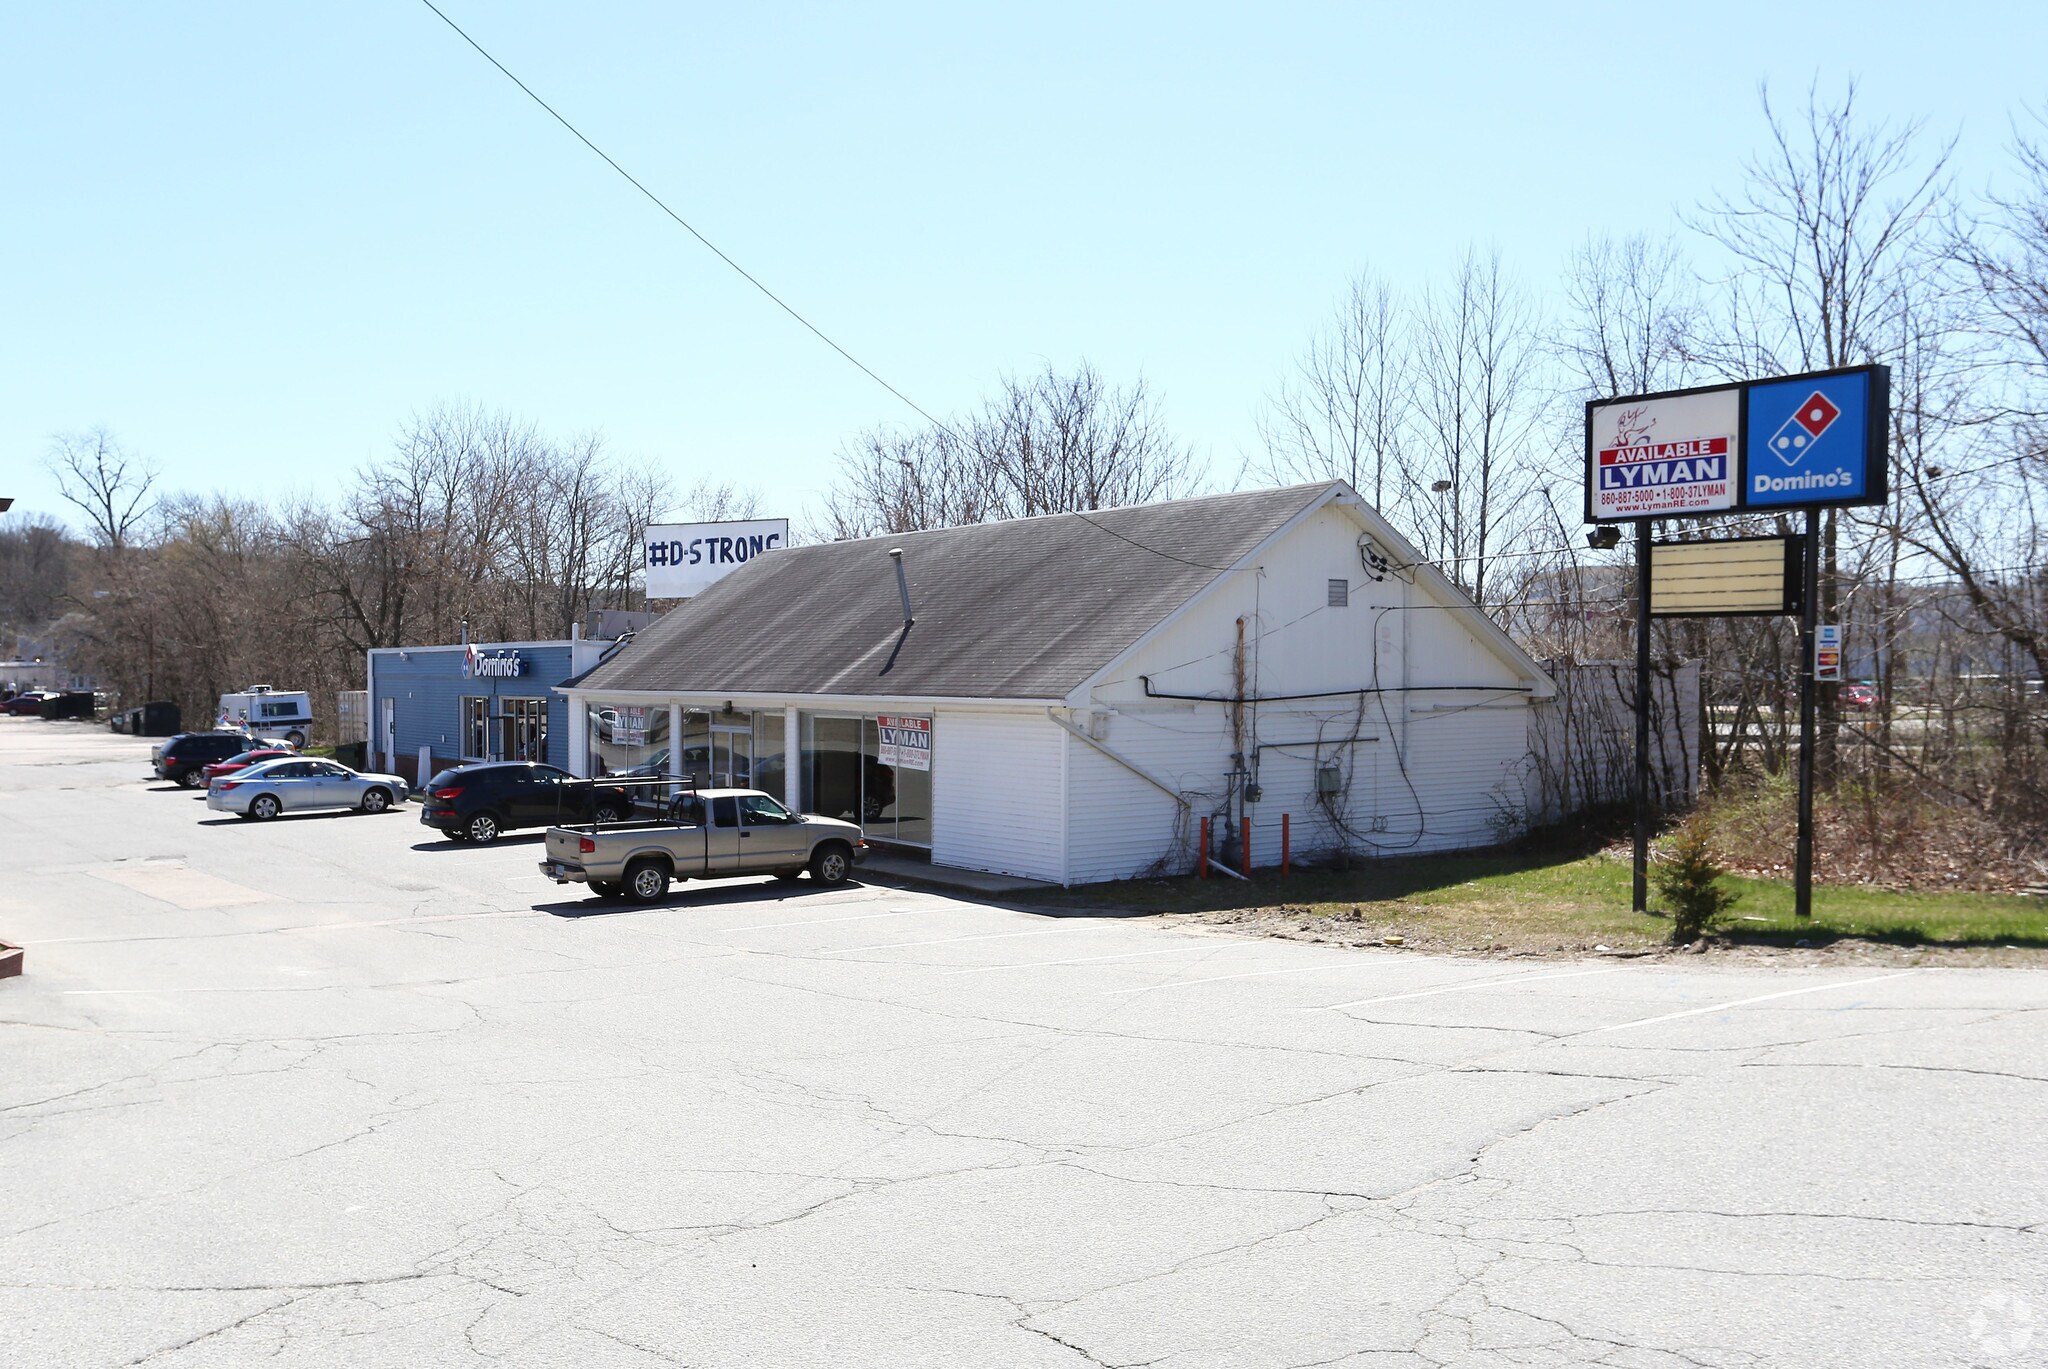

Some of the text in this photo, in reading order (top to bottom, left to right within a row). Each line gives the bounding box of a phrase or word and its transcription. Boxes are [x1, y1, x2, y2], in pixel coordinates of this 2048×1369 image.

[1615, 440, 1711, 463] AVAILABLE
[1604, 458, 1719, 488] LYMAN
[1754, 467, 1853, 493] Domino's
[1601, 483, 1726, 505] 860-887-5000 1-800-37LYMAN
[1615, 498, 1710, 512] www.LymanRE.com
[474, 650, 521, 677] Domino's
[886, 717, 922, 729] AVLABLE
[881, 729, 928, 748] LYMAN
